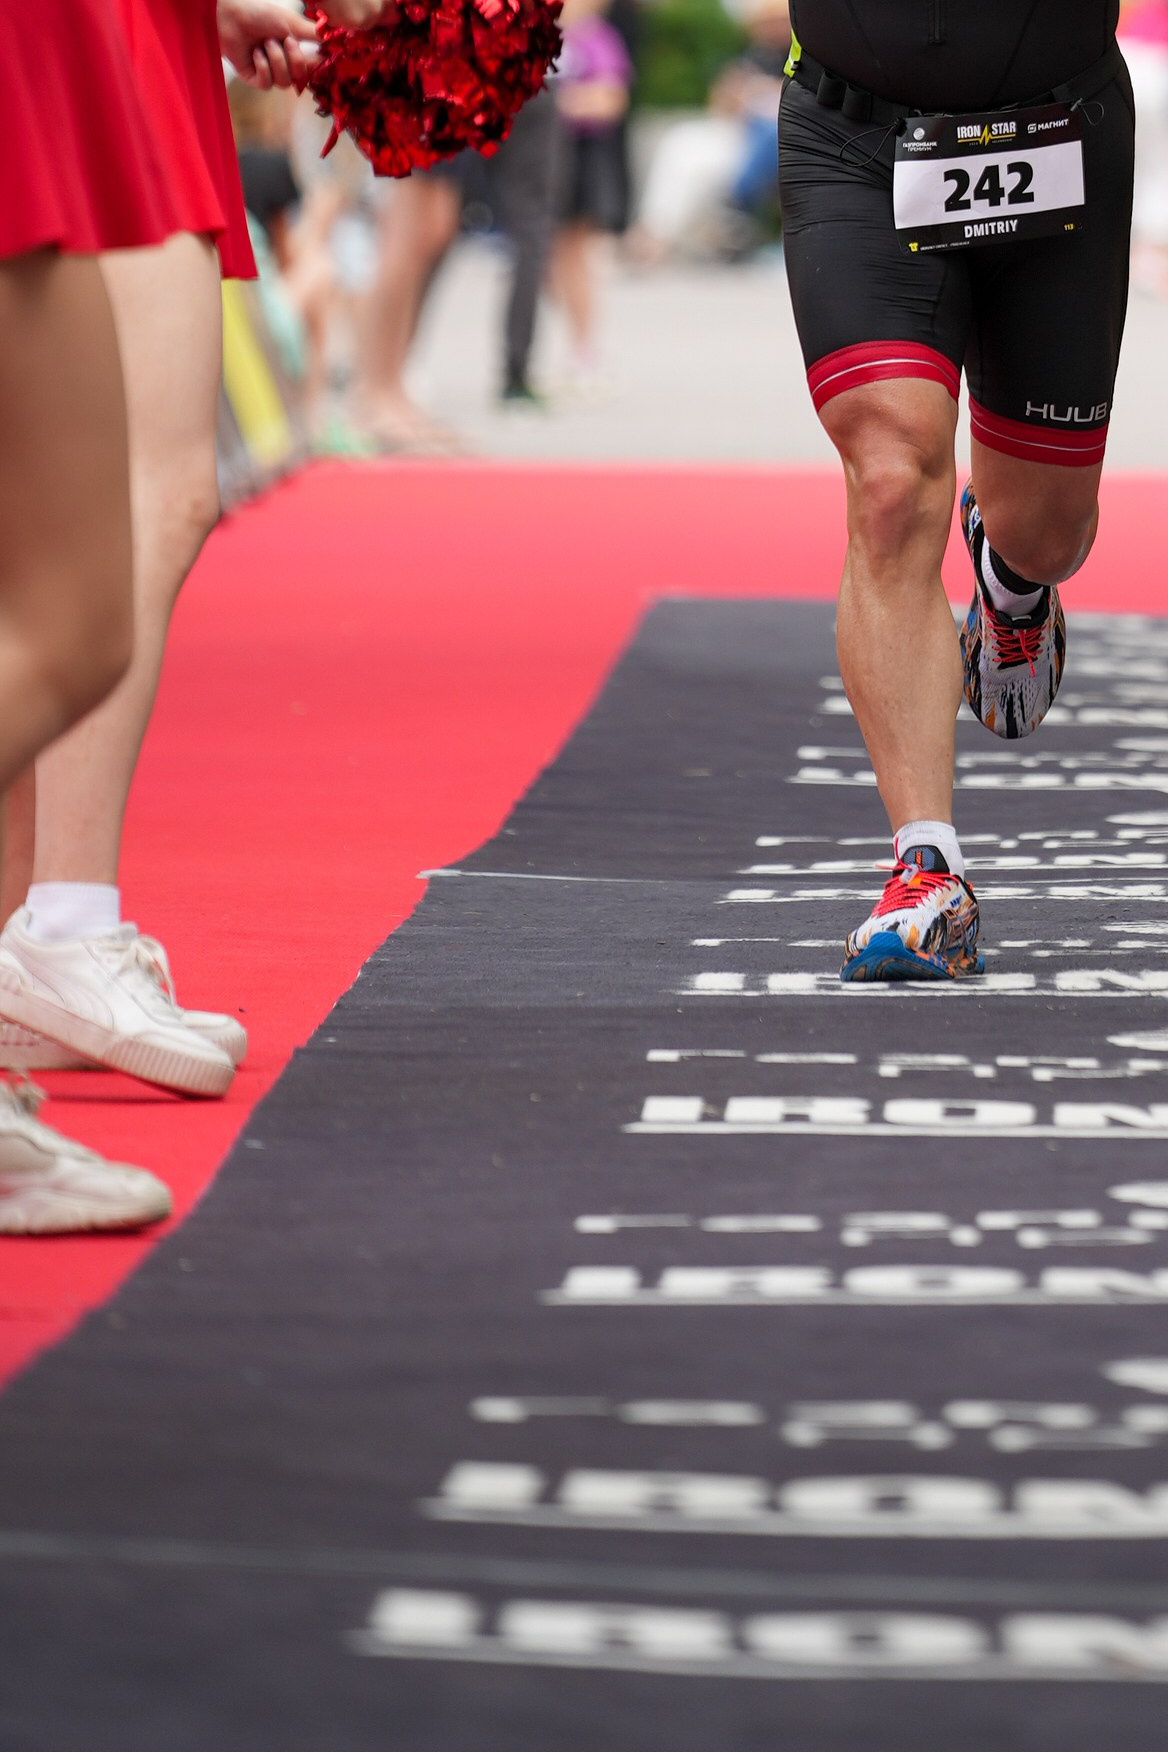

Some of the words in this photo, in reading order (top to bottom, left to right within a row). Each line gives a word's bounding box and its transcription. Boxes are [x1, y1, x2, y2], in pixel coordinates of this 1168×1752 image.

[957, 124, 981, 139] IRON
[991, 121, 1017, 136] STAR
[1038, 118, 1069, 131] МАГНИТ
[943, 161, 1035, 213] 242
[964, 219, 1019, 239] DMITRIY
[1025, 401, 1107, 423] HUUB
